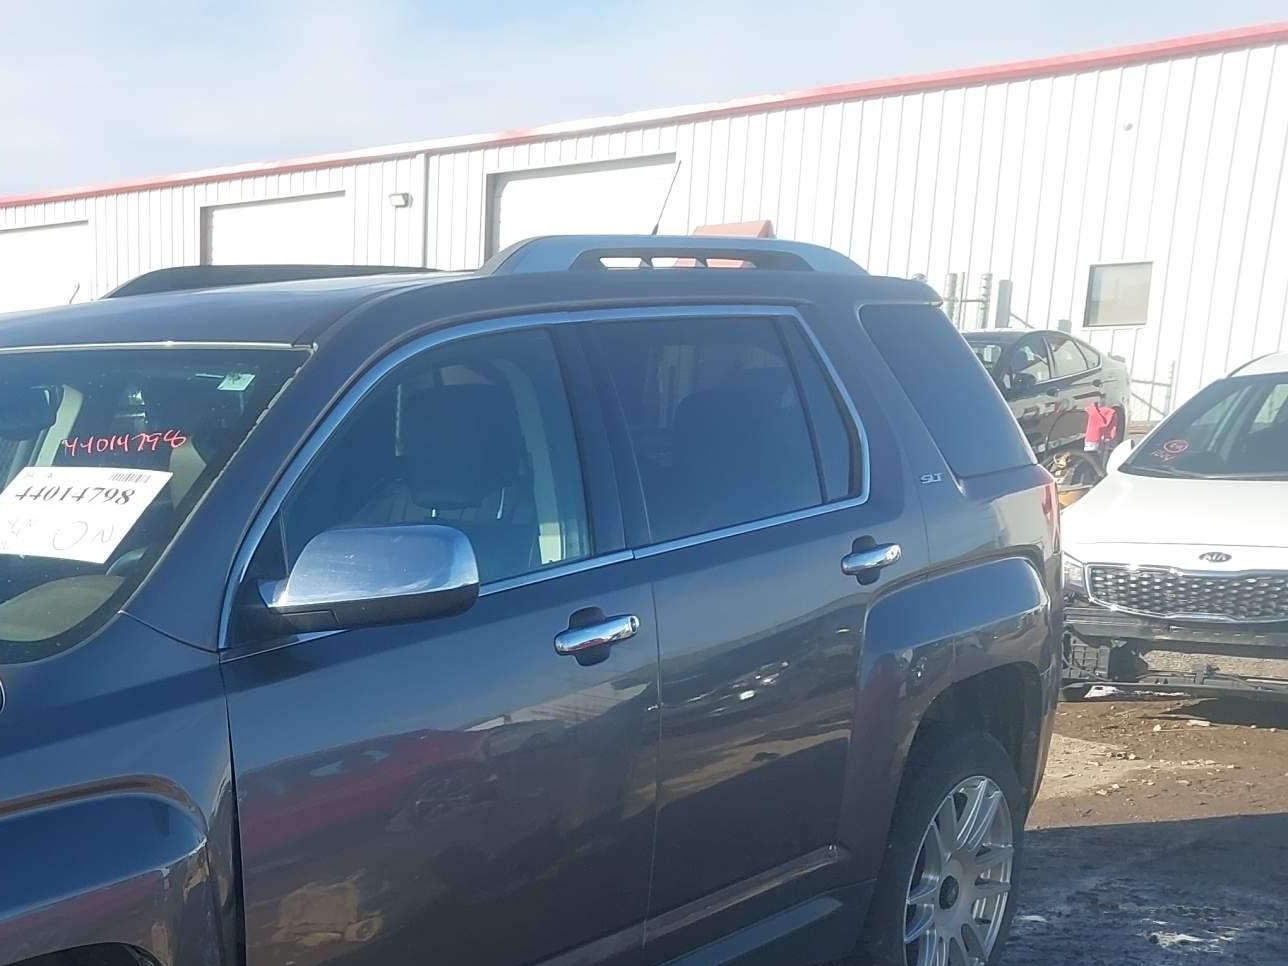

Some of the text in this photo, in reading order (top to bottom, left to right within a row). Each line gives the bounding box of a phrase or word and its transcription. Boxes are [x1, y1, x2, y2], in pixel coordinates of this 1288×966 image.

[62, 430, 188, 456] 44014798
[920, 472, 944, 484] SLT
[15, 485, 136, 506] 44014798
